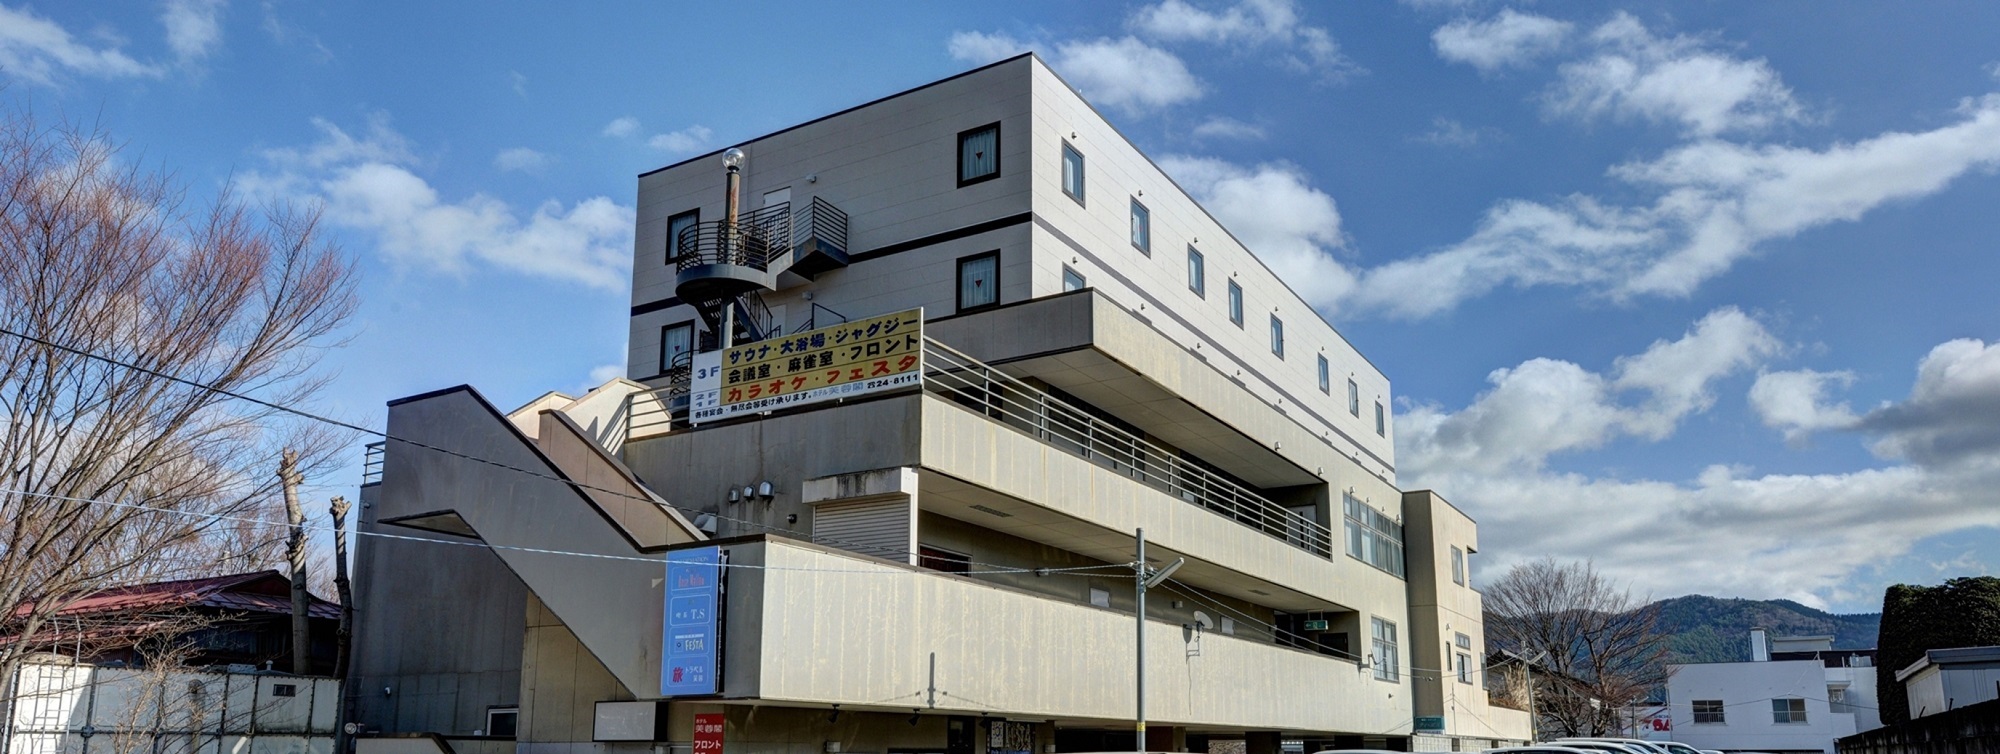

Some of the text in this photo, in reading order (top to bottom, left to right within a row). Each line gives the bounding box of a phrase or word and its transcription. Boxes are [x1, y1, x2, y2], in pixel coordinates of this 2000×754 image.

[697, 365, 720, 379] 3F
[727, 354, 917, 403] カラオケ・フェスタ
[695, 391, 718, 400] 2F
[695, 399, 717, 407] 1F
[685, 638, 704, 651] FESTA
[695, 740, 721, 749] フロント
